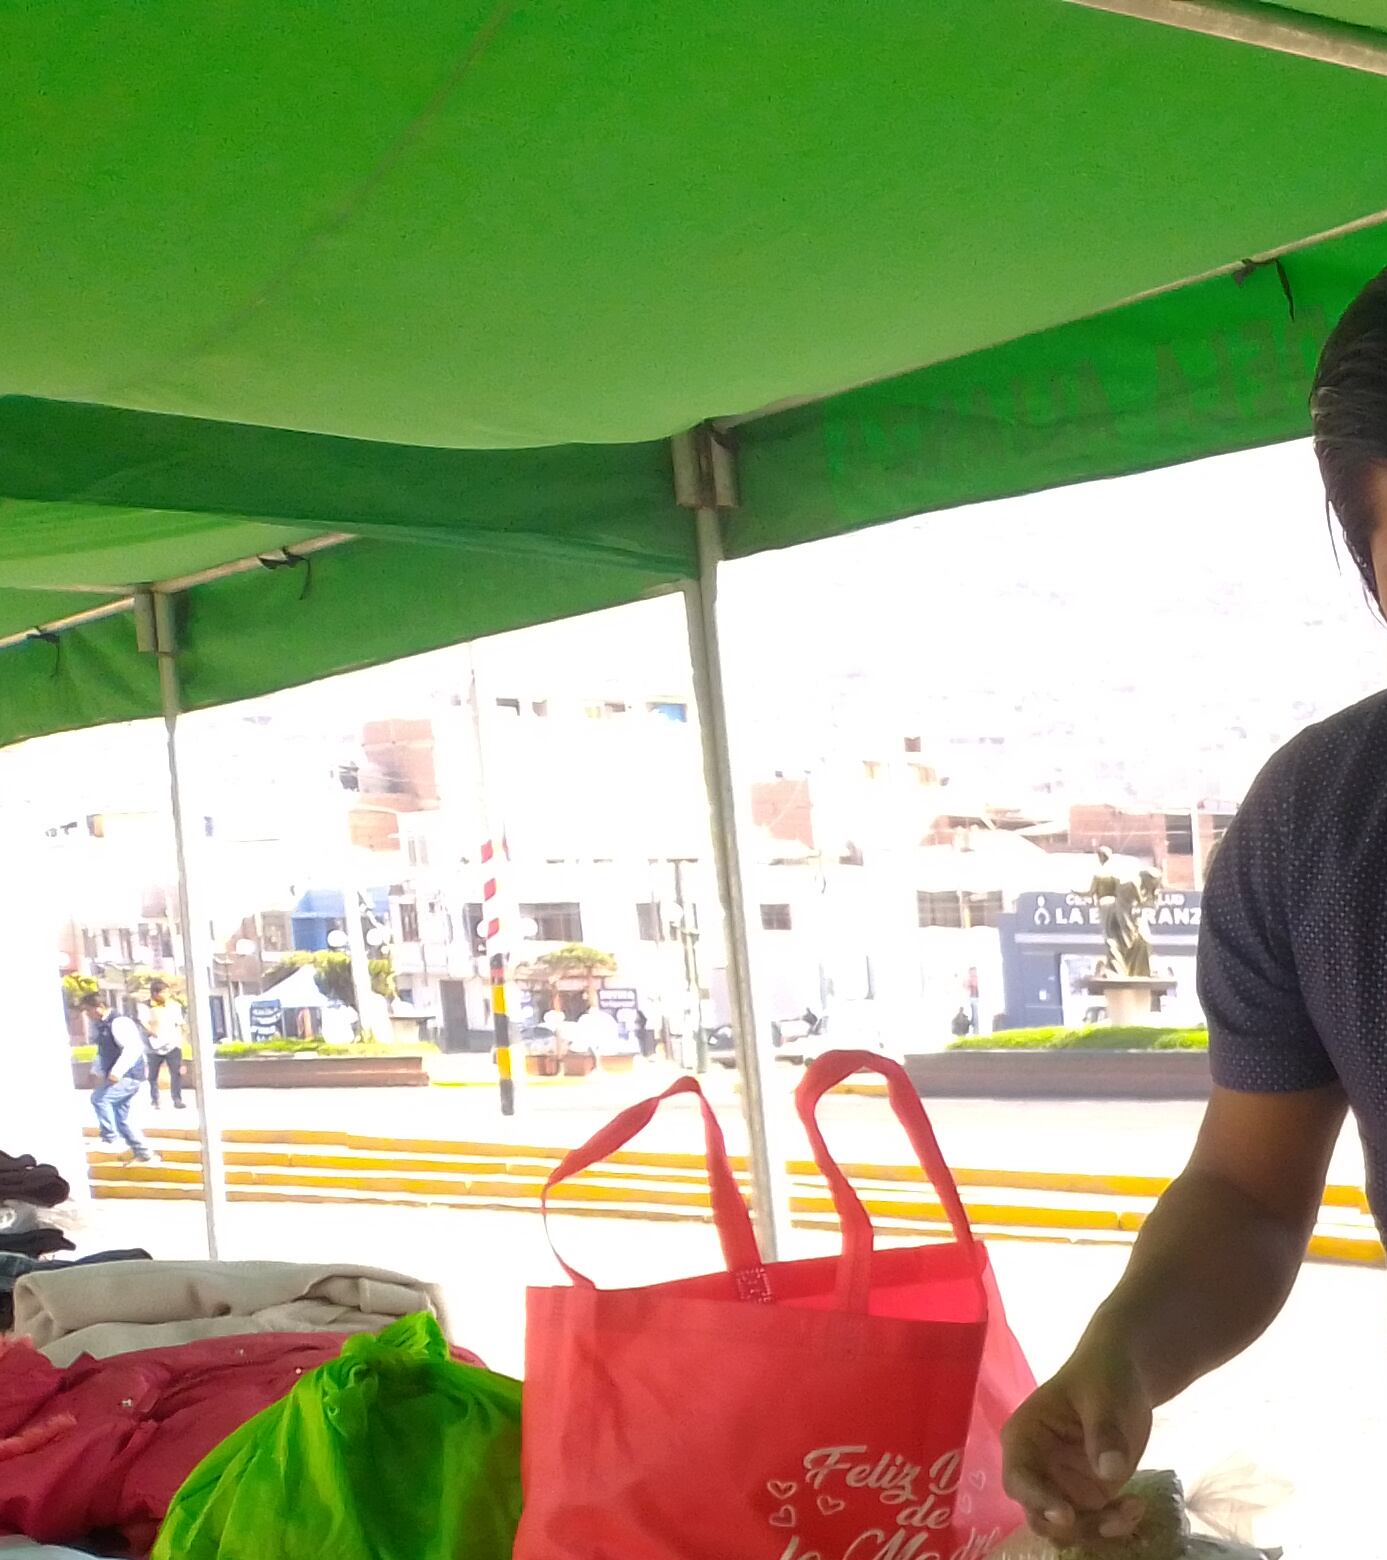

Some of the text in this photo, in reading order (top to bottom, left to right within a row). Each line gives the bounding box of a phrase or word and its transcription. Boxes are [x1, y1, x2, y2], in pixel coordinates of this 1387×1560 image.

[1055, 907, 1202, 925] LA ERANZ
[803, 1445, 921, 1504] Feliz
[896, 1495, 952, 1530] de
